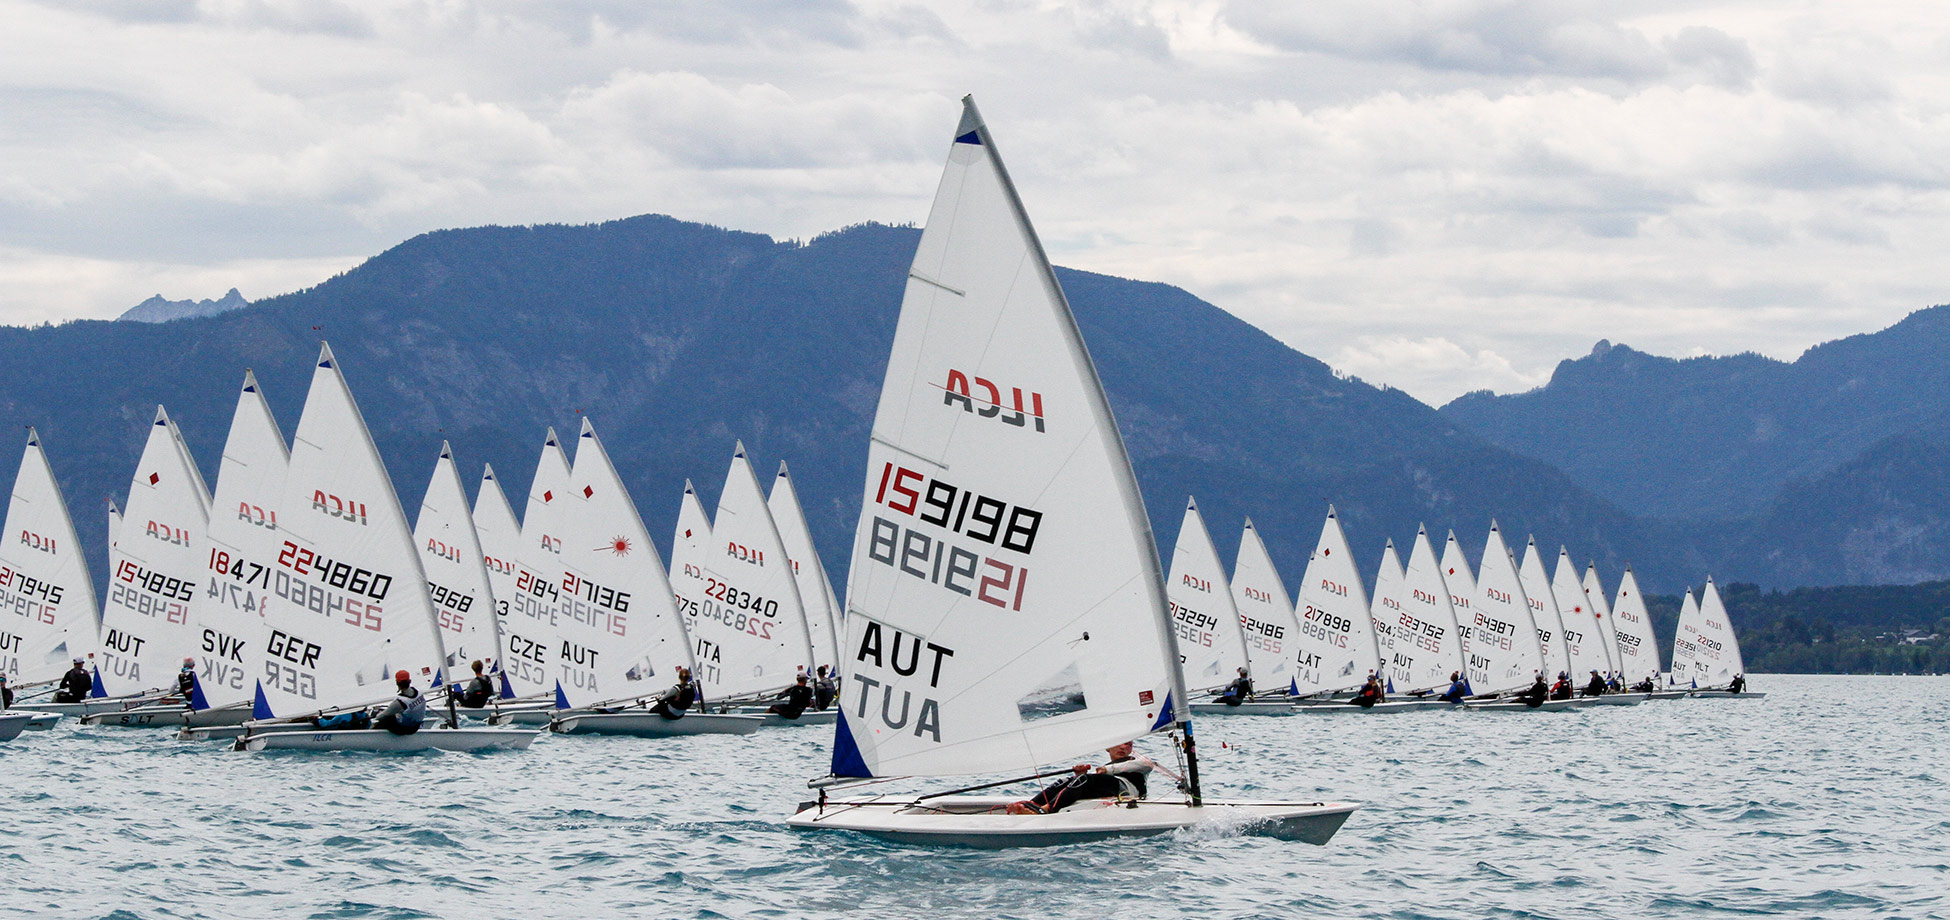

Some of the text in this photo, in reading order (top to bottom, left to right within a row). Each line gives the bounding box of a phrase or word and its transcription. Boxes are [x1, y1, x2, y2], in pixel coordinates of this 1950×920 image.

[875, 462, 1043, 555] 159198
[116, 559, 196, 602] 154895
[209, 547, 271, 590] 18471
[278, 540, 393, 601] 224860
[562, 572, 631, 613] 217136
[705, 578, 778, 618] 228340
[1304, 605, 1351, 633] 217898
[1398, 612, 1445, 640] 223752
[1473, 612, 1516, 637] 134387
[105, 629, 145, 657] AUT
[202, 628, 245, 664] SVK
[266, 629, 322, 670] GER
[510, 635, 547, 664] CZE
[697, 638, 721, 663] ITA
[1615, 629, 1642, 647] 8823
[1697, 634, 1722, 651] 221210
[561, 640, 599, 669] AUT
[857, 621, 954, 689] AUT
[1297, 649, 1322, 669] LAT
[1393, 652, 1414, 669] AUT
[1469, 653, 1491, 671] AUT
[1673, 661, 1686, 671] AUT
[1694, 661, 1709, 673] MLT
